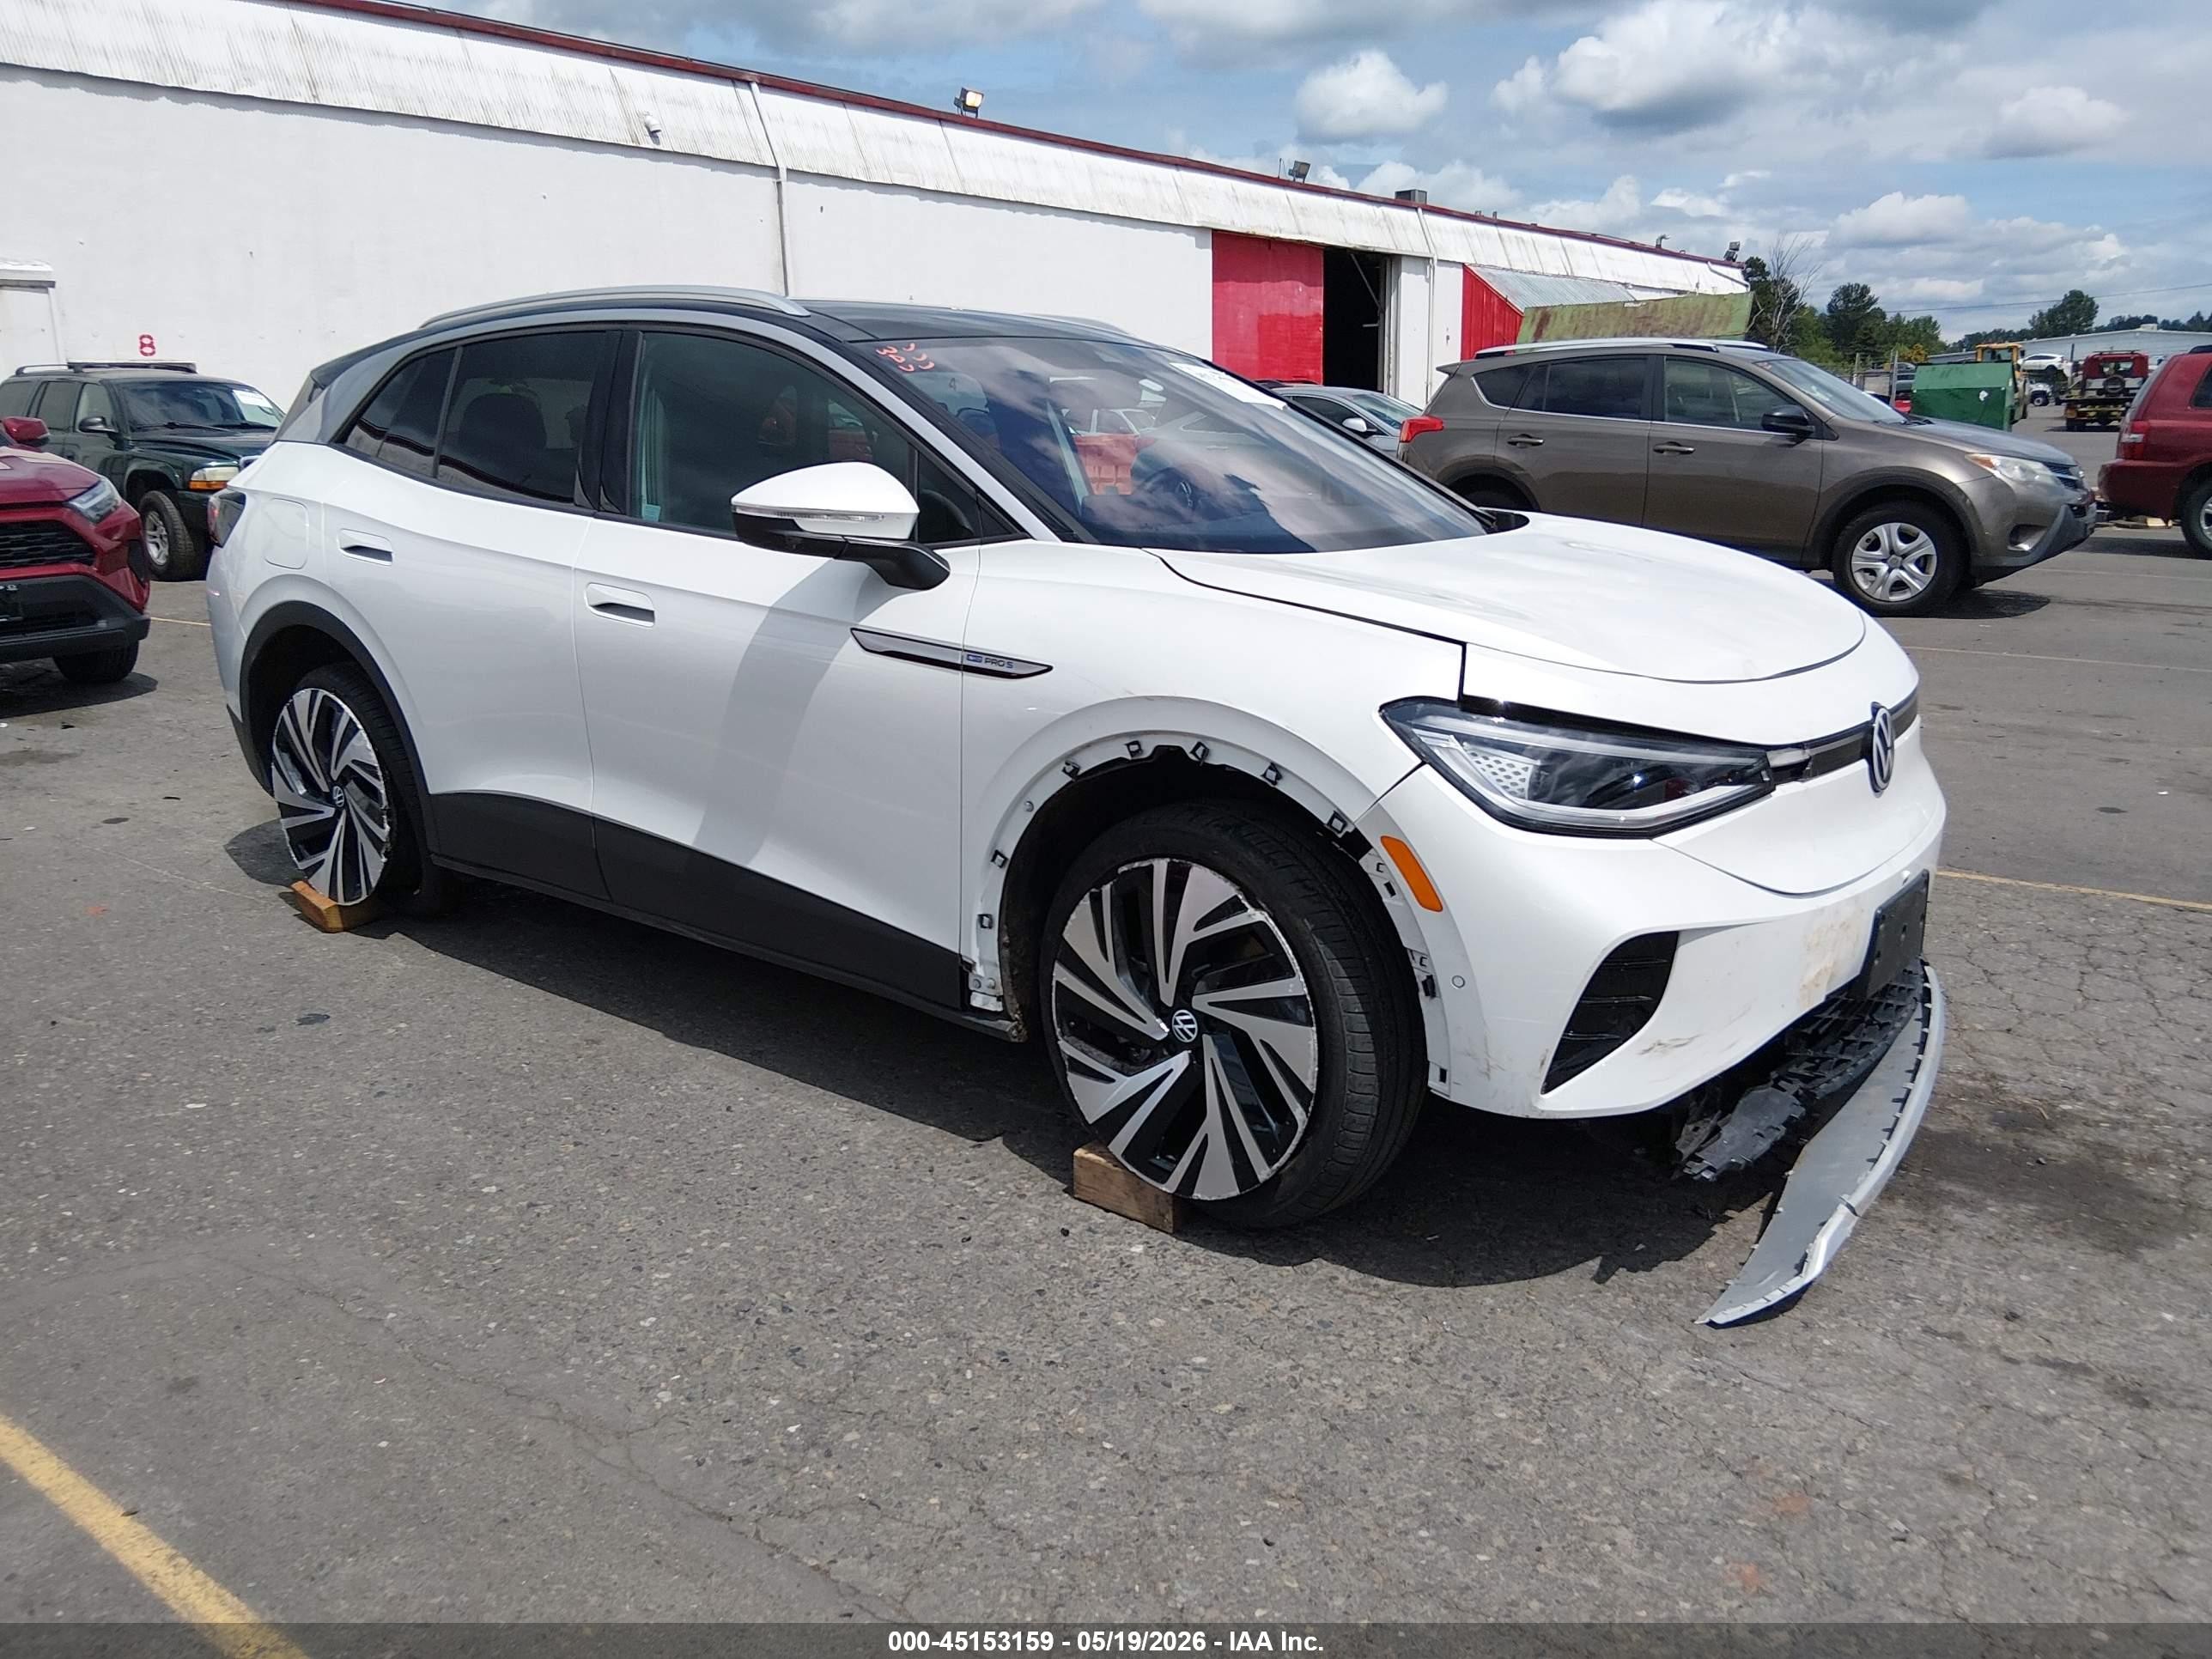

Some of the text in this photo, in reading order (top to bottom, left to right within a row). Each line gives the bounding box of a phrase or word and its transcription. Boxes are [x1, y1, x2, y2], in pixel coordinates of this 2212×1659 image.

[139, 334, 156, 356] 8
[984, 657, 1006, 667] PRO
[1006, 660, 1014, 669] S
